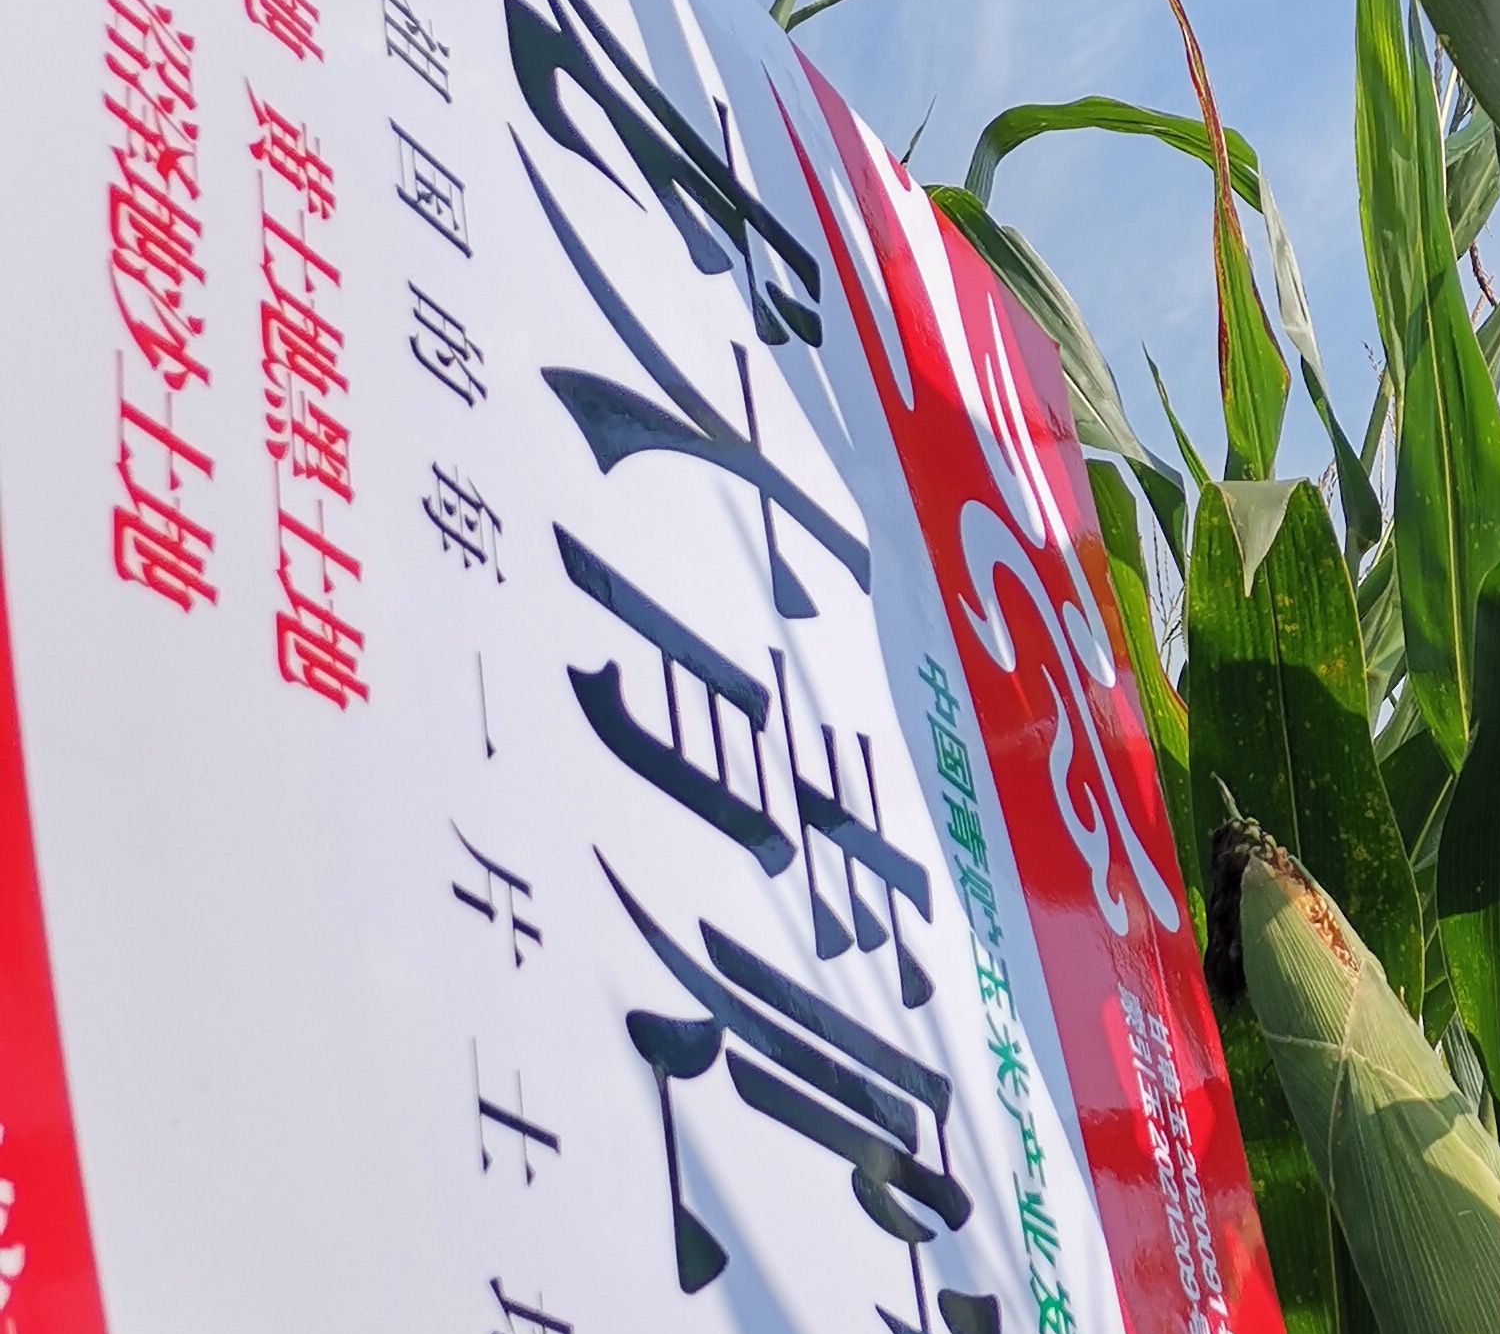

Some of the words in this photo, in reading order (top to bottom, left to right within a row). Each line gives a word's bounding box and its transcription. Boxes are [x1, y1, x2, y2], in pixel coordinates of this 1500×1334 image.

[244, 76, 371, 712] 黄土地黑土地
